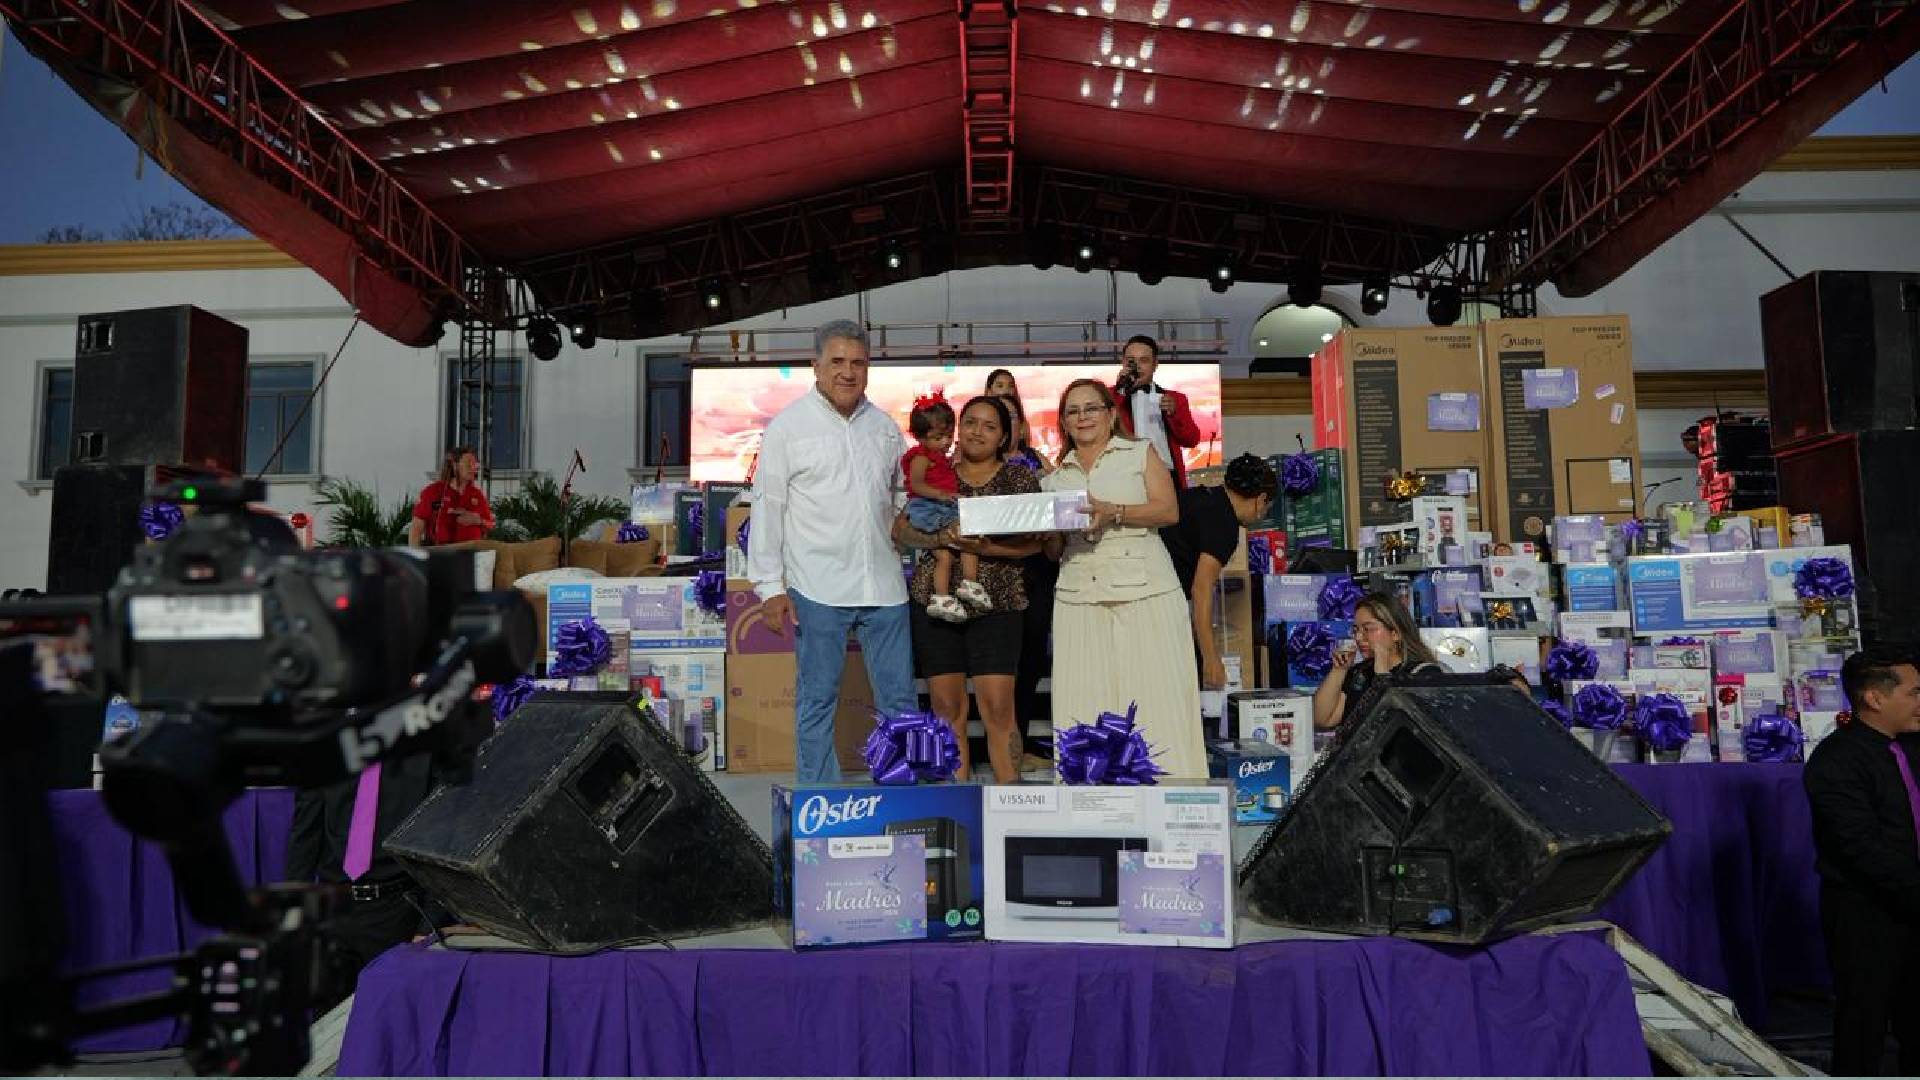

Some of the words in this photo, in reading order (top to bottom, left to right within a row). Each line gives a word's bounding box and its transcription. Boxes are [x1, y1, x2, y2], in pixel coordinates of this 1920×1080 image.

[1504, 334, 1542, 347] Midea
[1358, 343, 1395, 355] Midea
[1640, 566, 1674, 577] Midea
[1238, 760, 1275, 778] Oster
[999, 794, 1046, 805] VISSANI
[798, 794, 882, 835] Oster
[816, 886, 901, 912] Madres
[1134, 891, 1204, 912] Madres
